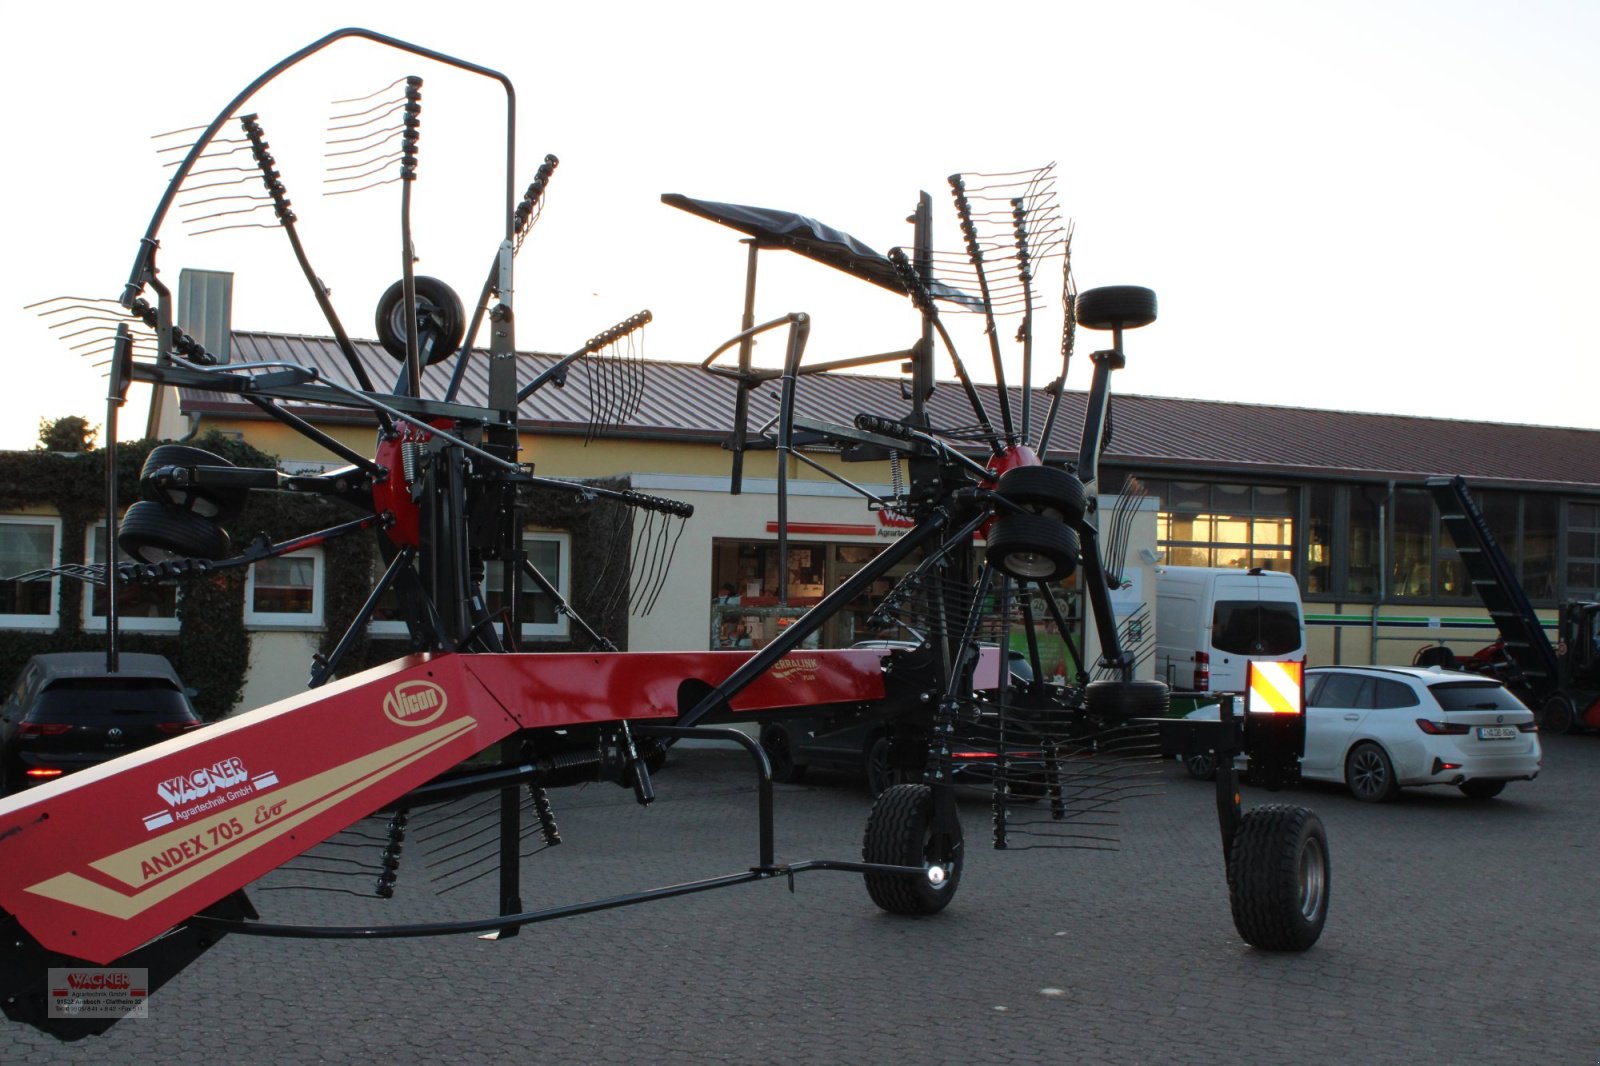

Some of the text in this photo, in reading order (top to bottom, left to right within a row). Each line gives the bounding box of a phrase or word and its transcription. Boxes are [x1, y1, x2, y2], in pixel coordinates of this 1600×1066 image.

[771, 659, 817, 669] ERRALINK
[387, 687, 439, 718] Vicon
[157, 757, 248, 807] WAGNER
[175, 785, 253, 820] Agrartechnik GmbH
[140, 799, 288, 880] ANDEX 705 Evo
